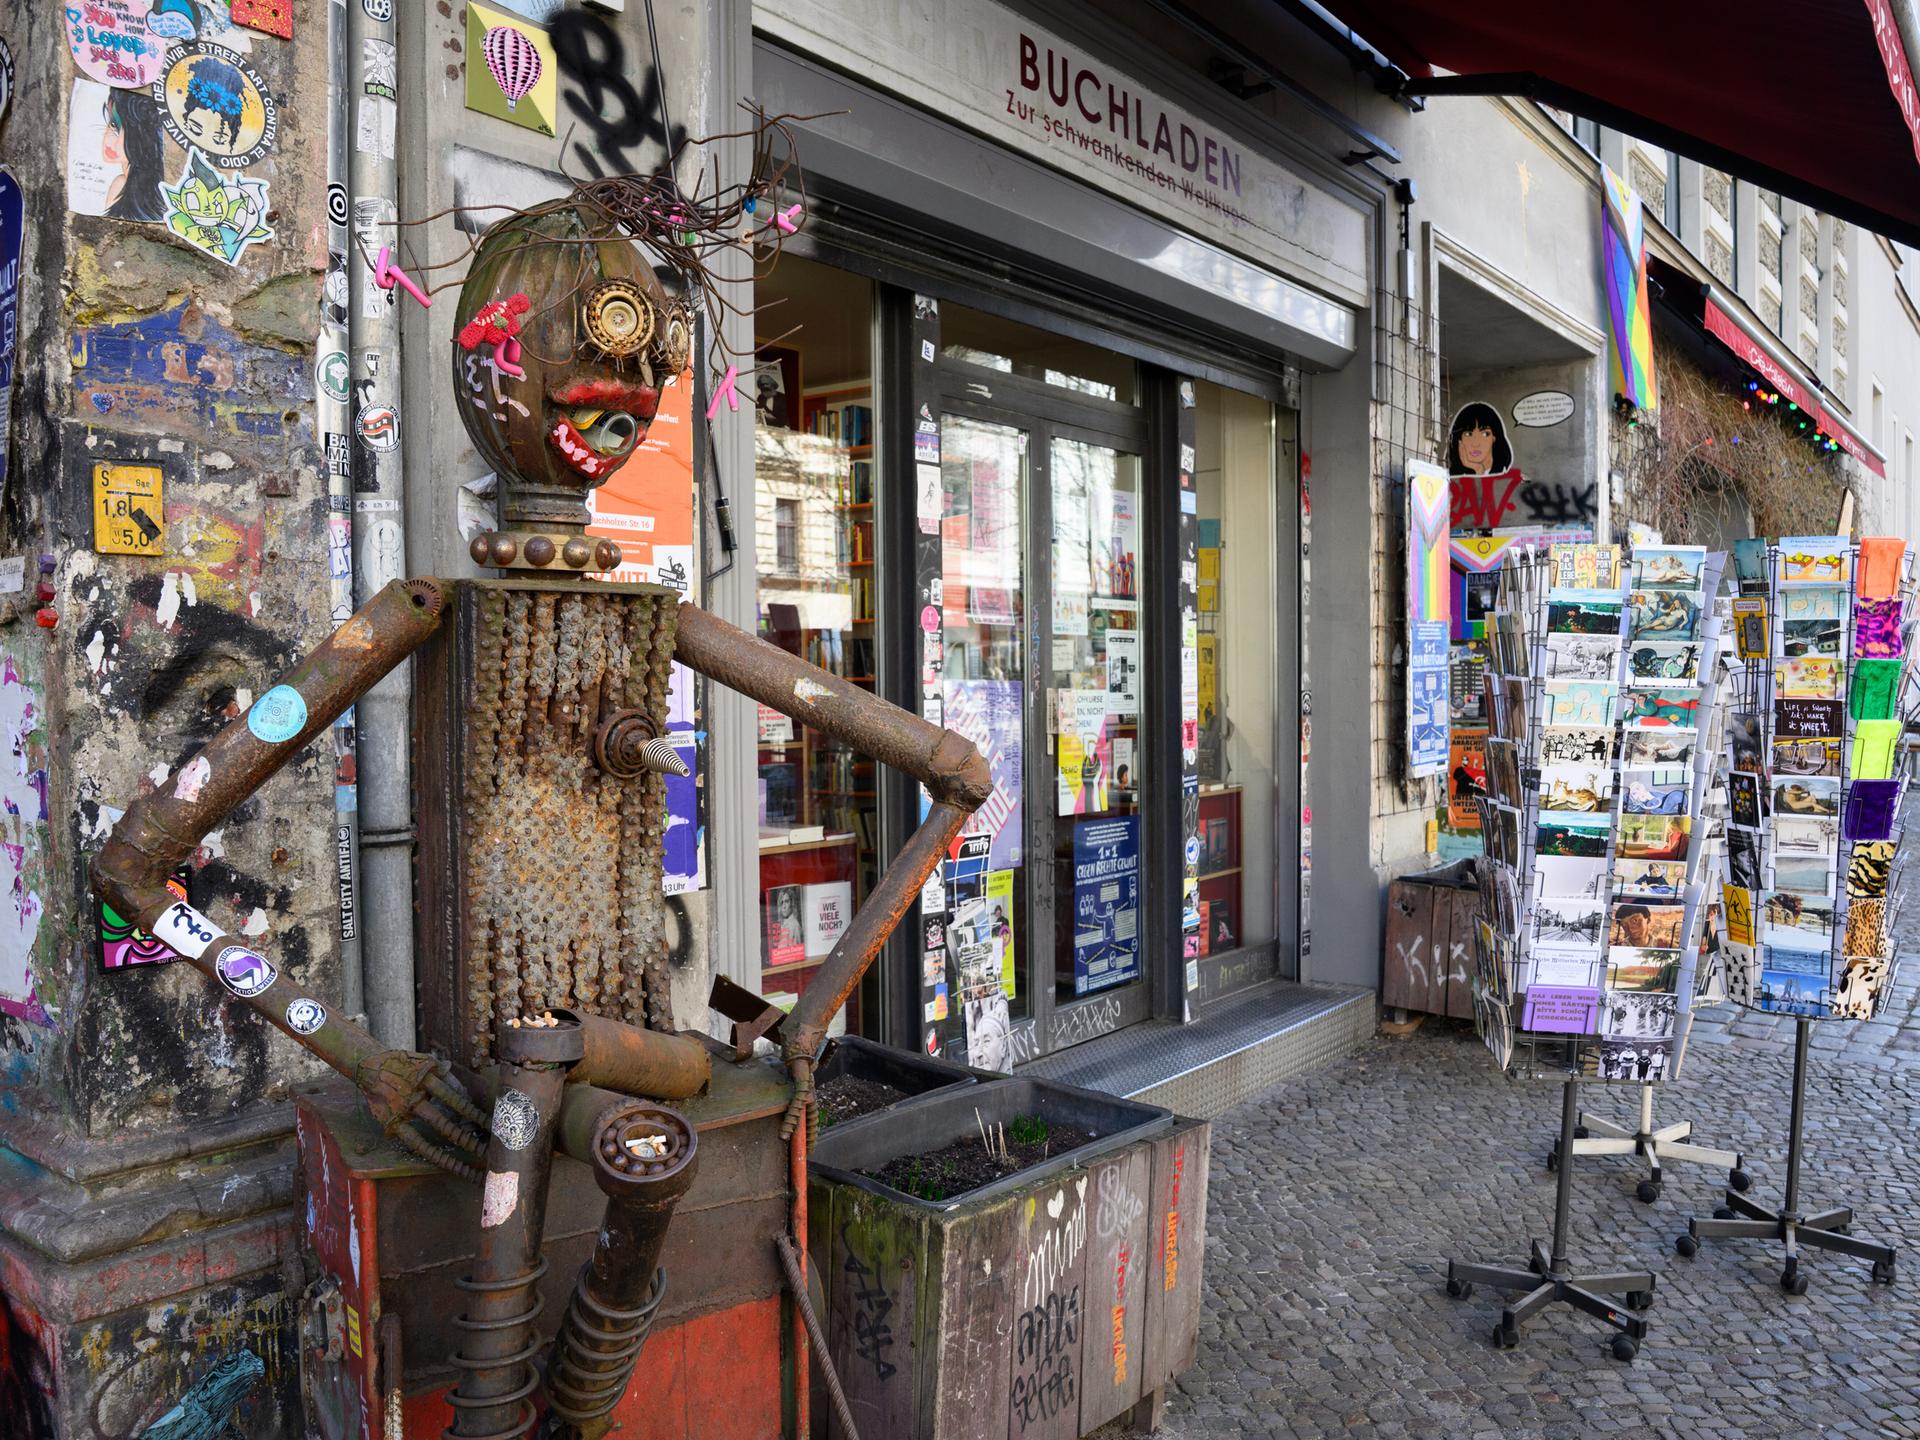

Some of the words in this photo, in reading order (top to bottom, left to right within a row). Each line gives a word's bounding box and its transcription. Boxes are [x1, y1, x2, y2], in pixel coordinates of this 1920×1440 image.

[116, 12, 145, 25] KNOW
[125, 24, 146, 35] HOW
[198, 43, 246, 67] STREET
[246, 70, 268, 93] ART
[157, 106, 168, 115] Y
[1020, 33, 1241, 197] BUCHLADEN
[261, 98, 276, 146] CONTRA
[163, 119, 188, 148] VIVE
[250, 146, 266, 158] EL
[1043, 114, 1176, 193] schwankenden
[221, 157, 250, 167] ODIO
[101, 470, 109, 487] S
[102, 499, 127, 518] 1,8
[591, 516, 628, 528] uchholzer
[642, 521, 650, 529] 16
[123, 529, 150, 549] 5,0
[339, 839, 351, 880] ANTIFA
[673, 882, 686, 891] Uhr
[340, 884, 352, 910] CITY
[823, 902, 837, 911] WIE
[342, 911, 354, 938] SALT
[819, 912, 840, 921] VIELE
[819, 921, 843, 931] NOCH?
[233, 986, 257, 995] AKTION
